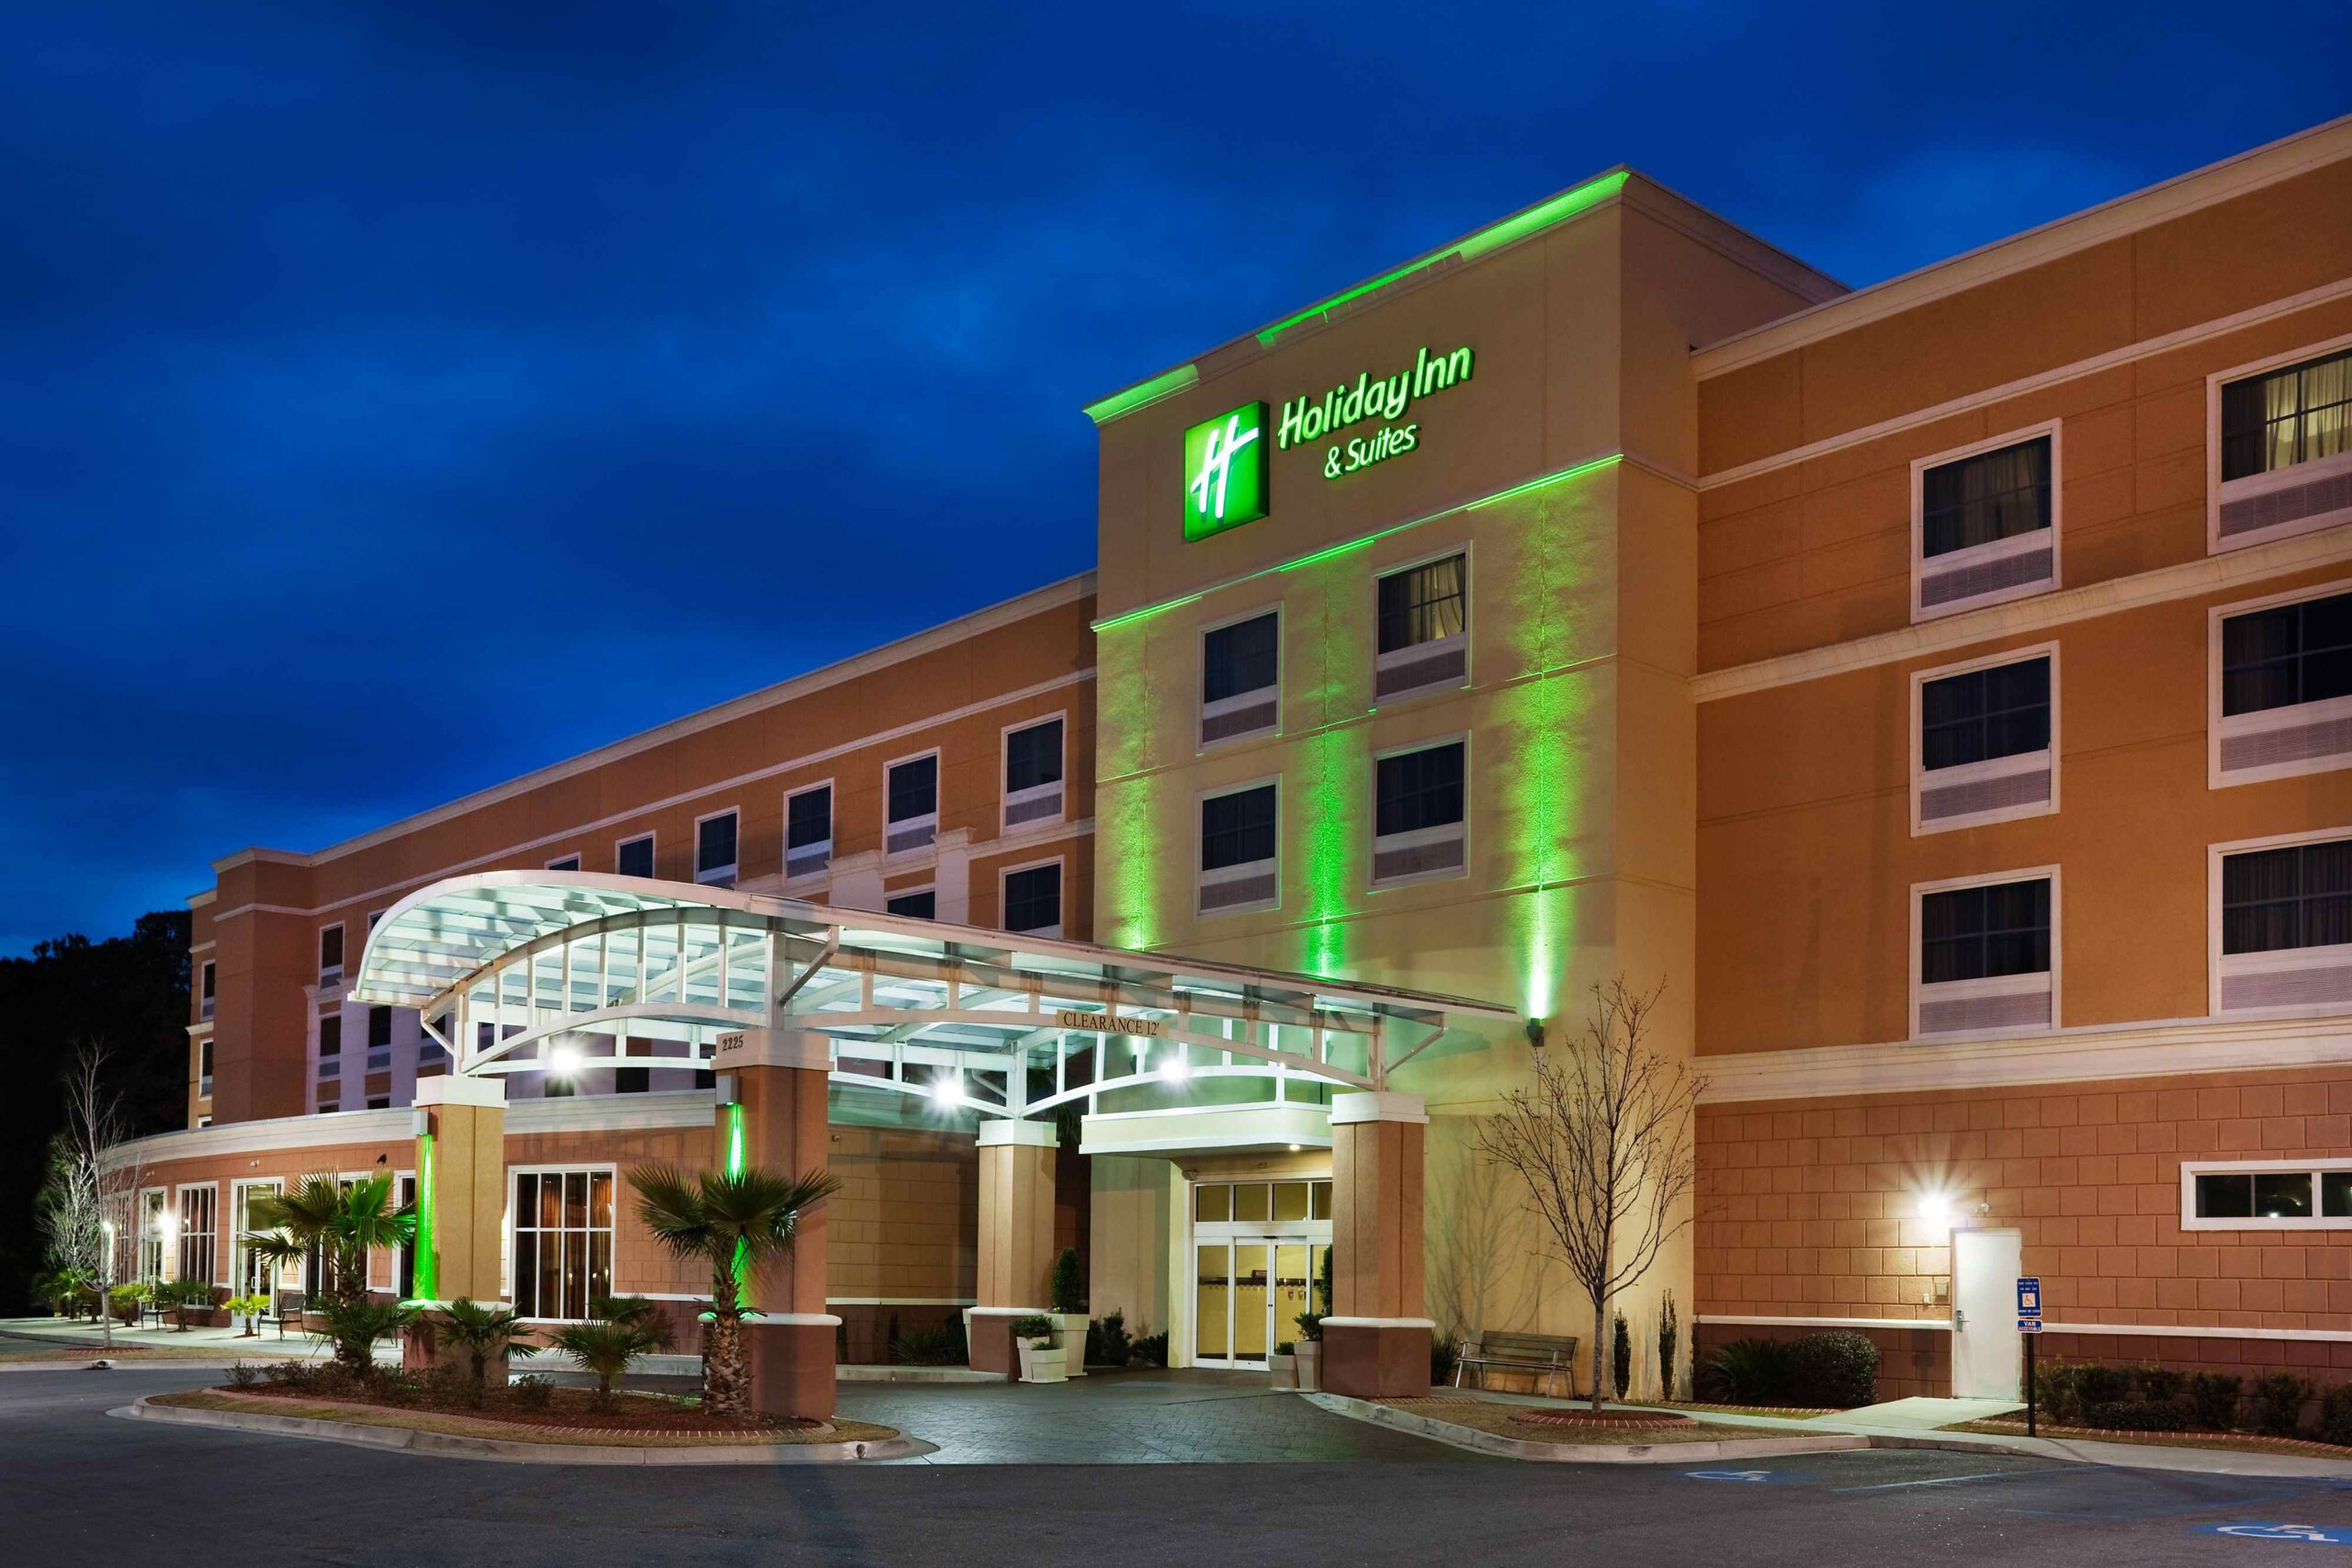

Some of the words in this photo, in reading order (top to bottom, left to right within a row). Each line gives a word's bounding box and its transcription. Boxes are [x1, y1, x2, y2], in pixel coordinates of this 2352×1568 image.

[1278, 371, 1410, 449] Holiday
[1413, 345, 1473, 398] Inn
[1324, 446, 1345, 479] &
[1345, 423, 1419, 471] Suites
[723, 1034, 743, 1051] 2225
[1063, 1011, 1143, 1034] CLEARANCE
[1147, 1021, 1160, 1036] 12'
